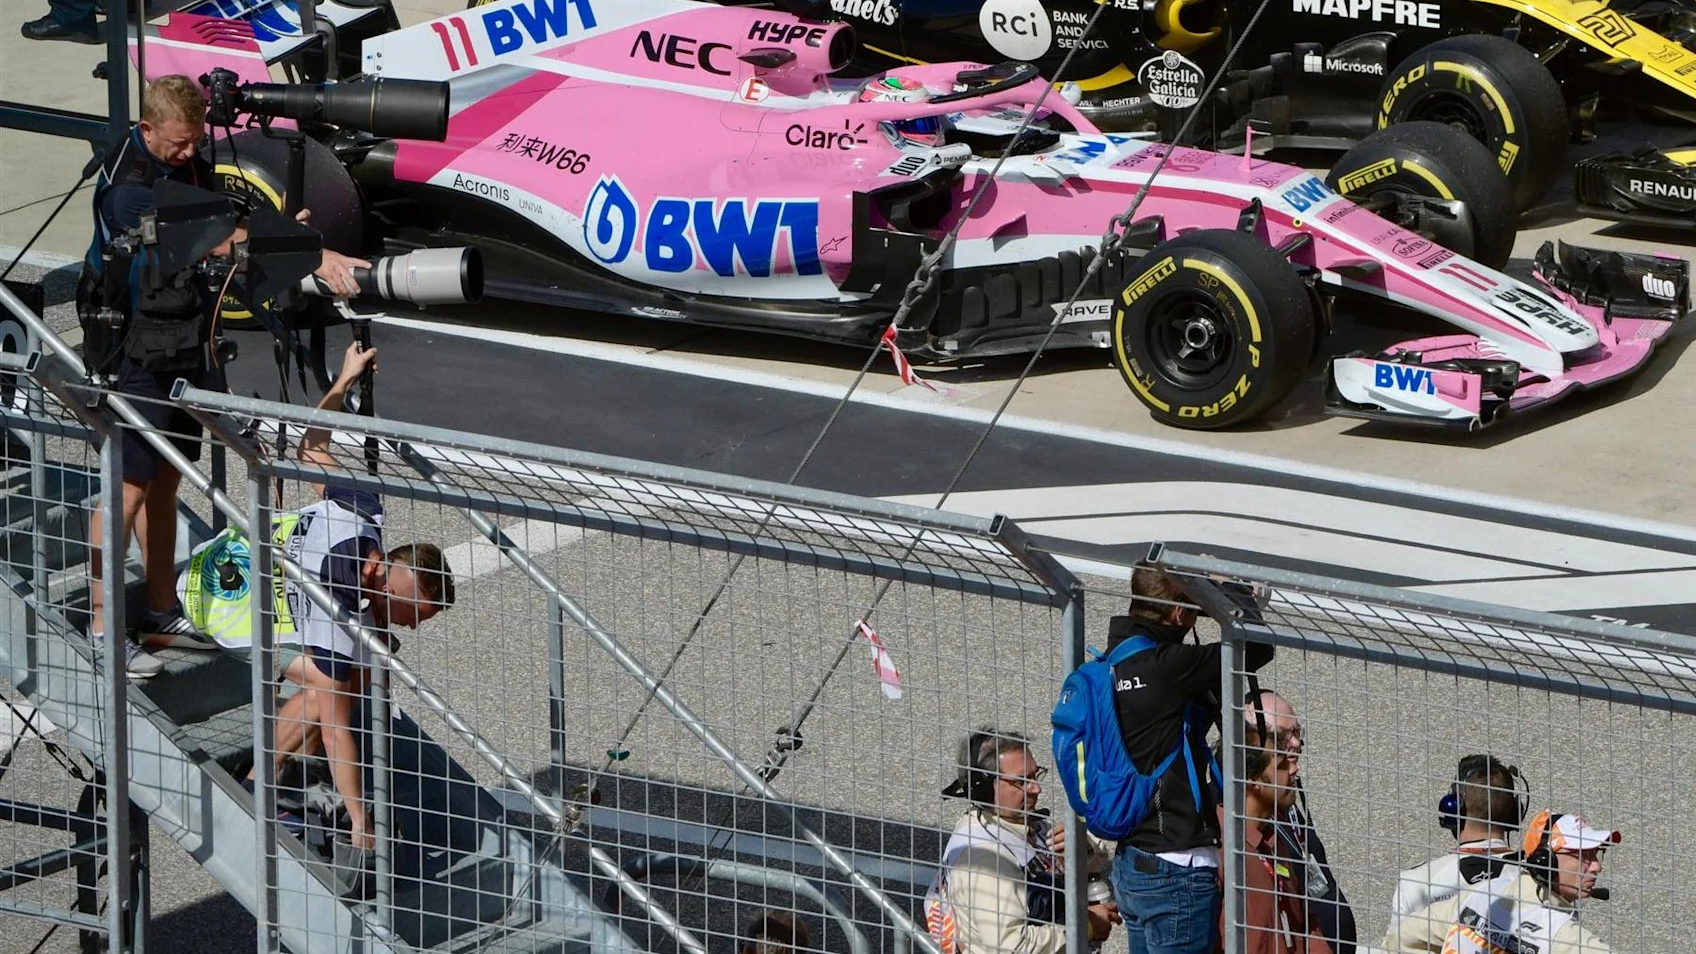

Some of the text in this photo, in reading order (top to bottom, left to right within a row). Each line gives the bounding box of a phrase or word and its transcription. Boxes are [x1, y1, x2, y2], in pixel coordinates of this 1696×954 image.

[1052, 10, 1089, 25] BANK
[1056, 23, 1084, 36] AND
[431, 16, 479, 72] 11
[747, 20, 827, 49] HYPE
[629, 30, 733, 77] NEC
[1326, 58, 1384, 76] Microsoft
[1146, 65, 1199, 85] Estrella
[884, 94, 911, 104] NEC
[1103, 97, 1141, 108] HECHTER
[1148, 81, 1197, 99] Galicia
[785, 122, 858, 152] Claro
[500, 132, 591, 176] 利来W66
[889, 155, 926, 177] duo
[453, 172, 510, 202] Acronis
[1337, 157, 1399, 195] PIRELLI
[646, 198, 823, 278] BWT
[1417, 249, 1455, 270] PIRELLI
[1121, 255, 1177, 307] PIRELLI
[1438, 262, 1500, 292] 11
[1642, 272, 1675, 299] duo
[1374, 363, 1438, 396] BWT
[1177, 373, 1252, 419] ZERO
